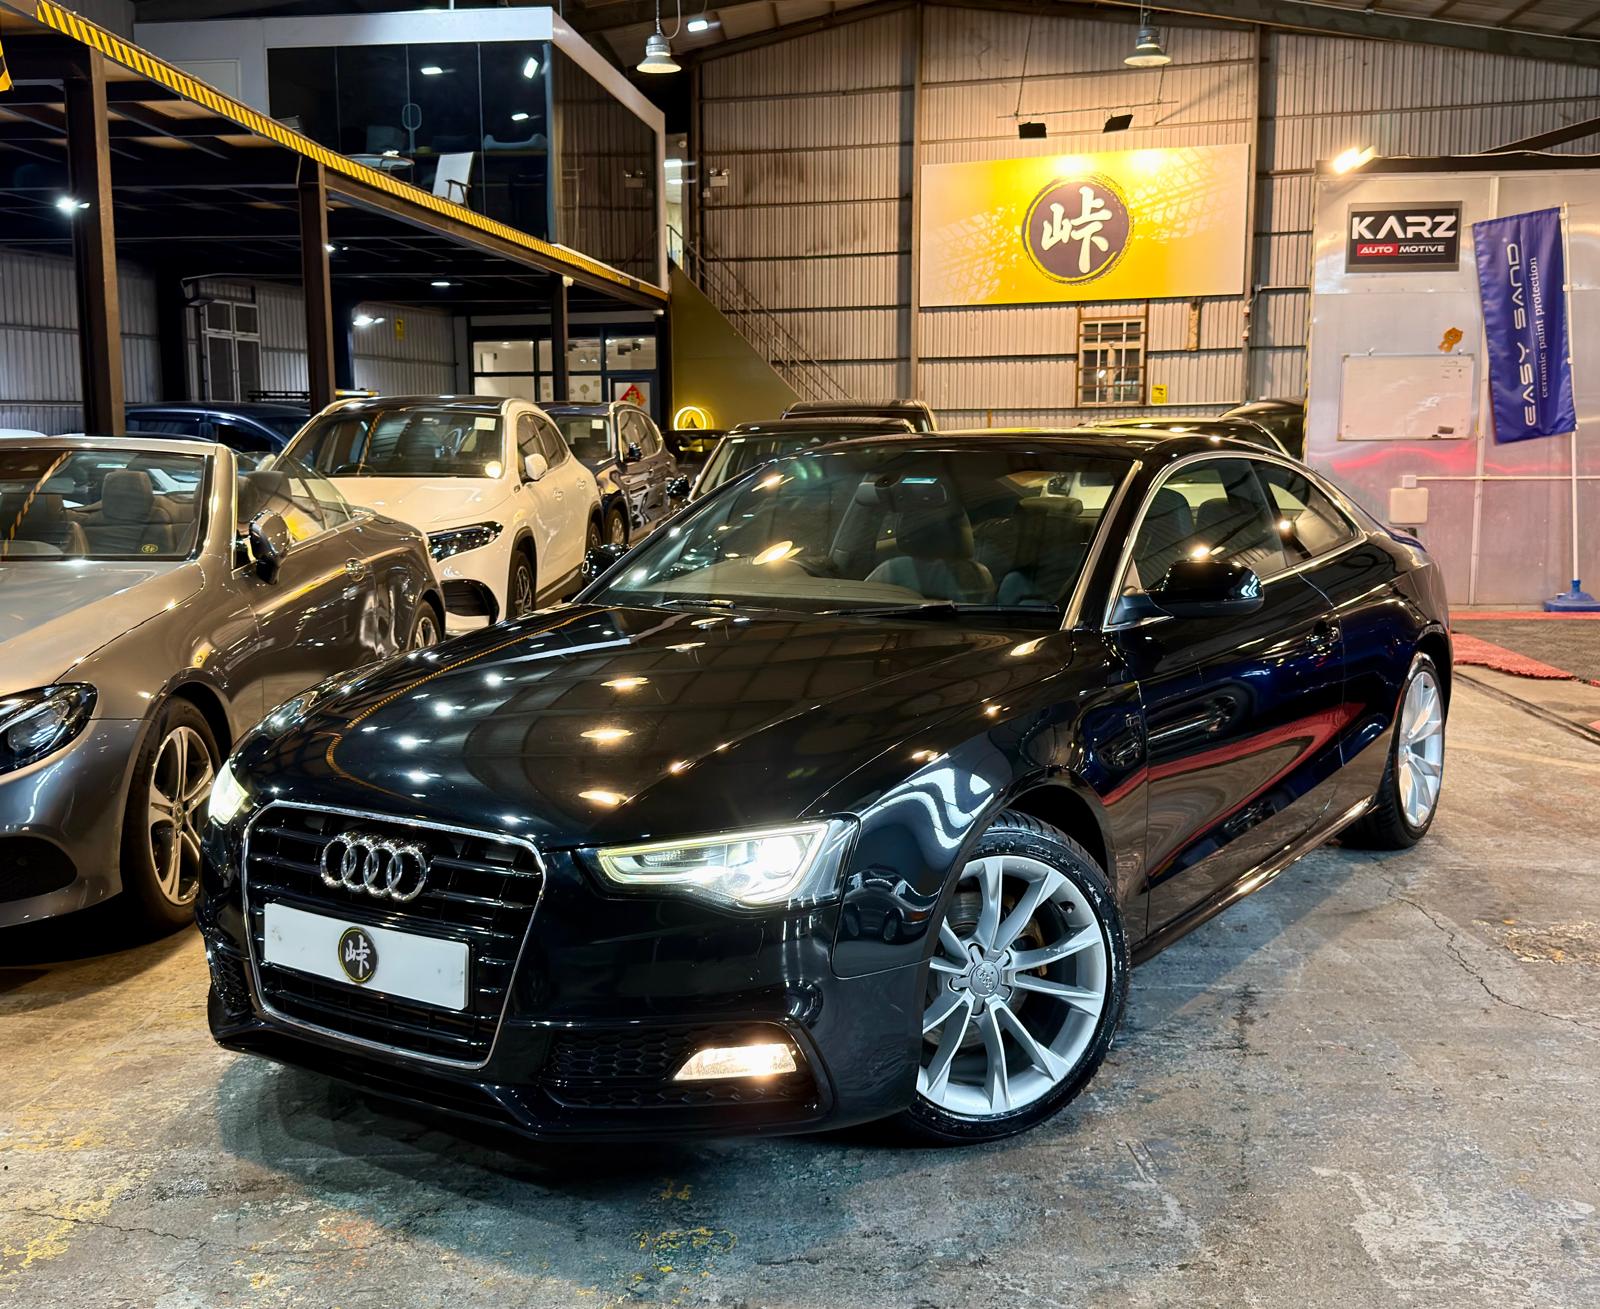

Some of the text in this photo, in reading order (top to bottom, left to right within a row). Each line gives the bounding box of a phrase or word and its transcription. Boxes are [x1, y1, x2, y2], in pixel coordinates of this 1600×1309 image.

[1041, 186, 1113, 274] 峠
[1351, 215, 1457, 240] KARZ
[1360, 244, 1445, 254] AUTO MOTIVE
[1506, 243, 1537, 427] EASY SAND
[1529, 256, 1549, 398] ceramic paint protection
[345, 934, 371, 978] 峠
